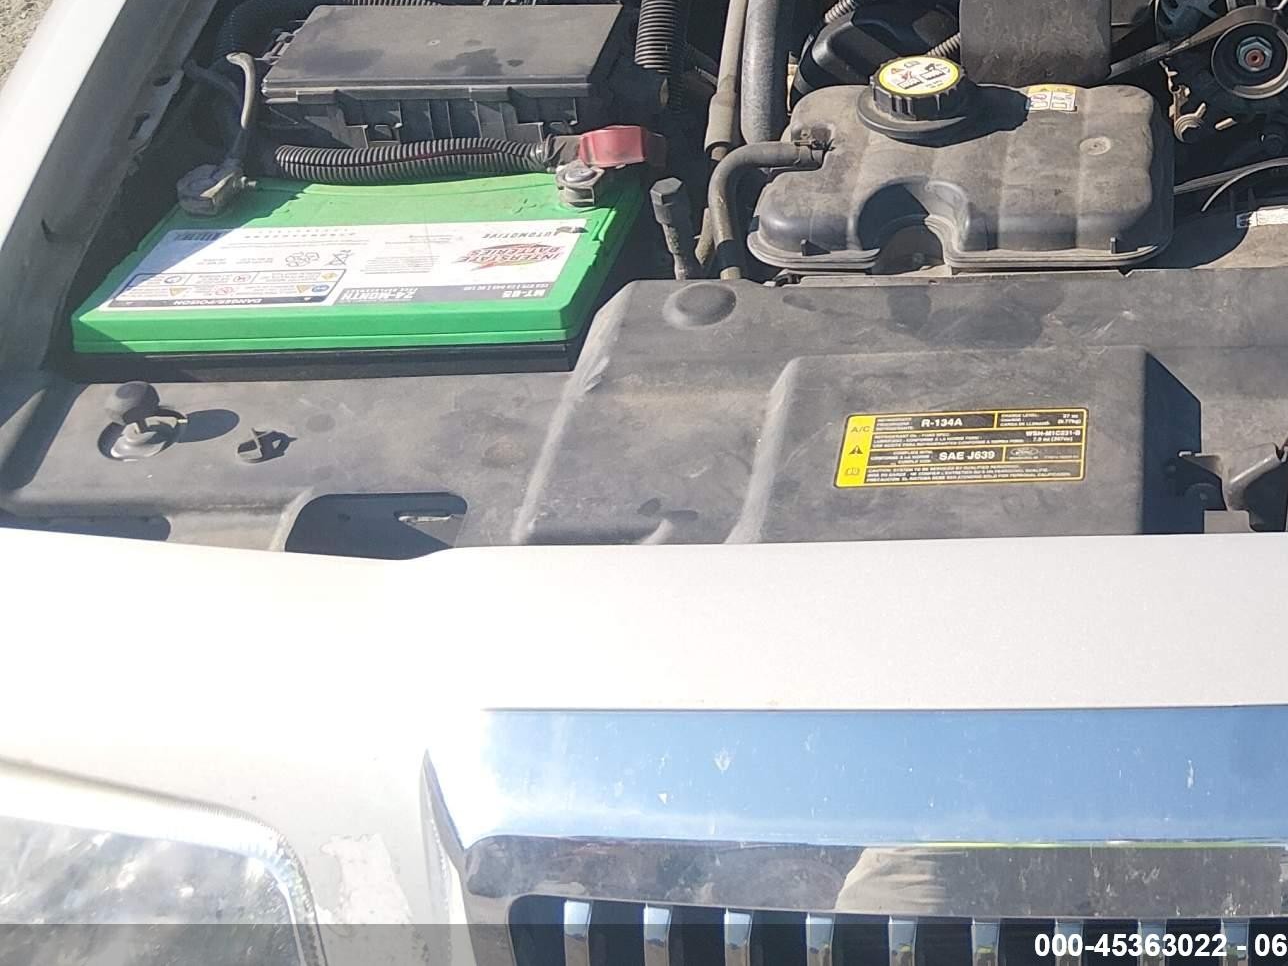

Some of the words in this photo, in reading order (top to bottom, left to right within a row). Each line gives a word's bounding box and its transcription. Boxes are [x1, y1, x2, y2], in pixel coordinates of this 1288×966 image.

[469, 246, 560, 255] BATTERIES
[460, 253, 560, 262] INTERSTATE
[341, 290, 416, 300] 24-MONTH
[921, 418, 963, 428] R-134A
[850, 425, 870, 433] A/C
[939, 451, 964, 461] SAE
[967, 450, 995, 460] J639
